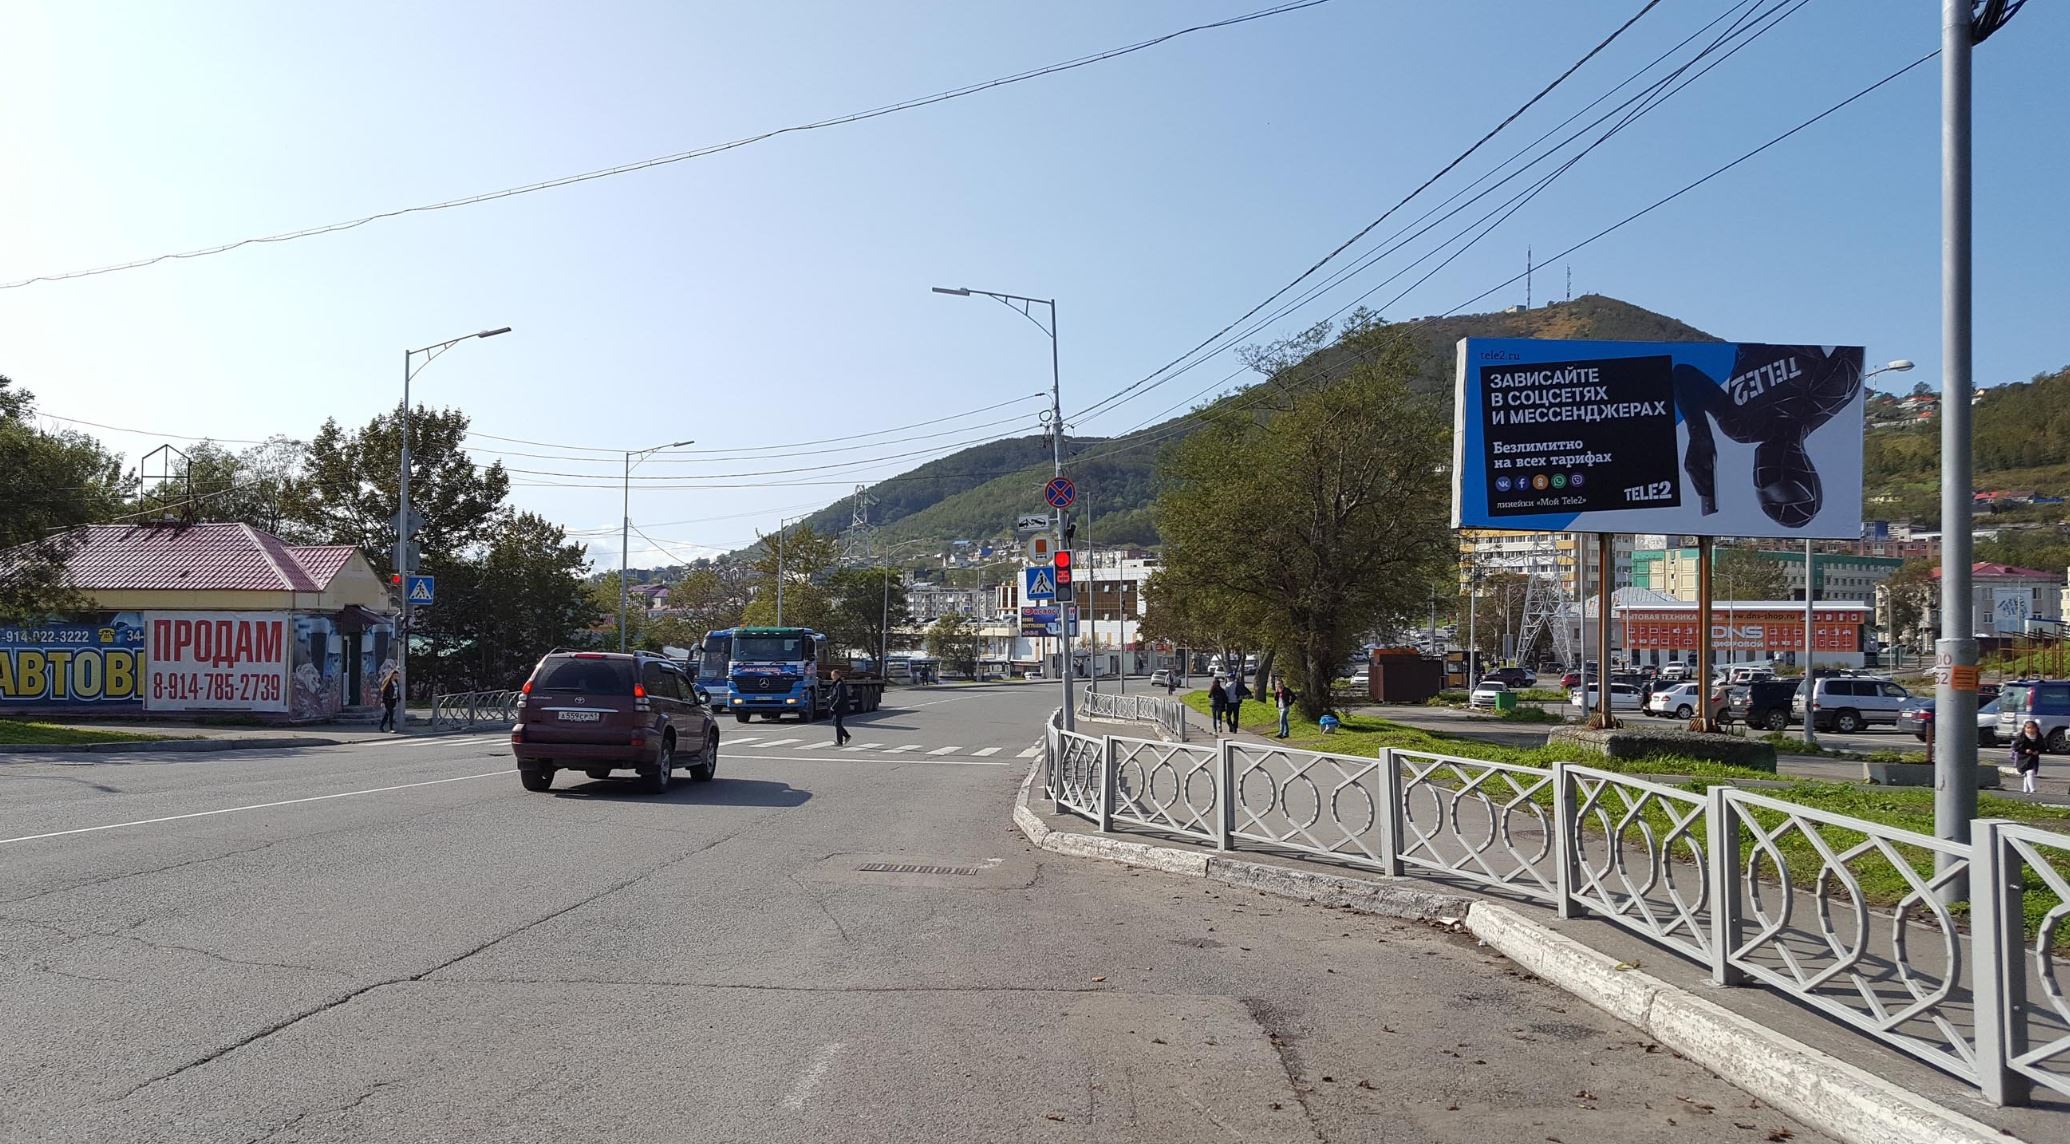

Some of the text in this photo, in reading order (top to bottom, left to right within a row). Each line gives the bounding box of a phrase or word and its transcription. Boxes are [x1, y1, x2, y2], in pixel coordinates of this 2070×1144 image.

[1480, 350, 1520, 361] tele2.ru
[1490, 367, 1600, 388] ЗАВИСАЙТЕ
[1730, 357, 1802, 406] TELE2
[1491, 386, 1608, 407] В СОЦСЕТЯХ
[1492, 401, 1667, 425] И МЕССЕНДЖЕРАХ
[1493, 440, 1584, 455] Безлимитно
[1494, 451, 1612, 469] на всех тарифах
[1624, 481, 1672, 502] TELE2
[1497, 499, 1535, 509] линейки
[1712, 626, 1763, 639] DNS
[153, 619, 283, 669] ПРОДАМ
[0, 647, 144, 700] АВТОВ
[153, 672, 280, 701] 8-914-785-2739
